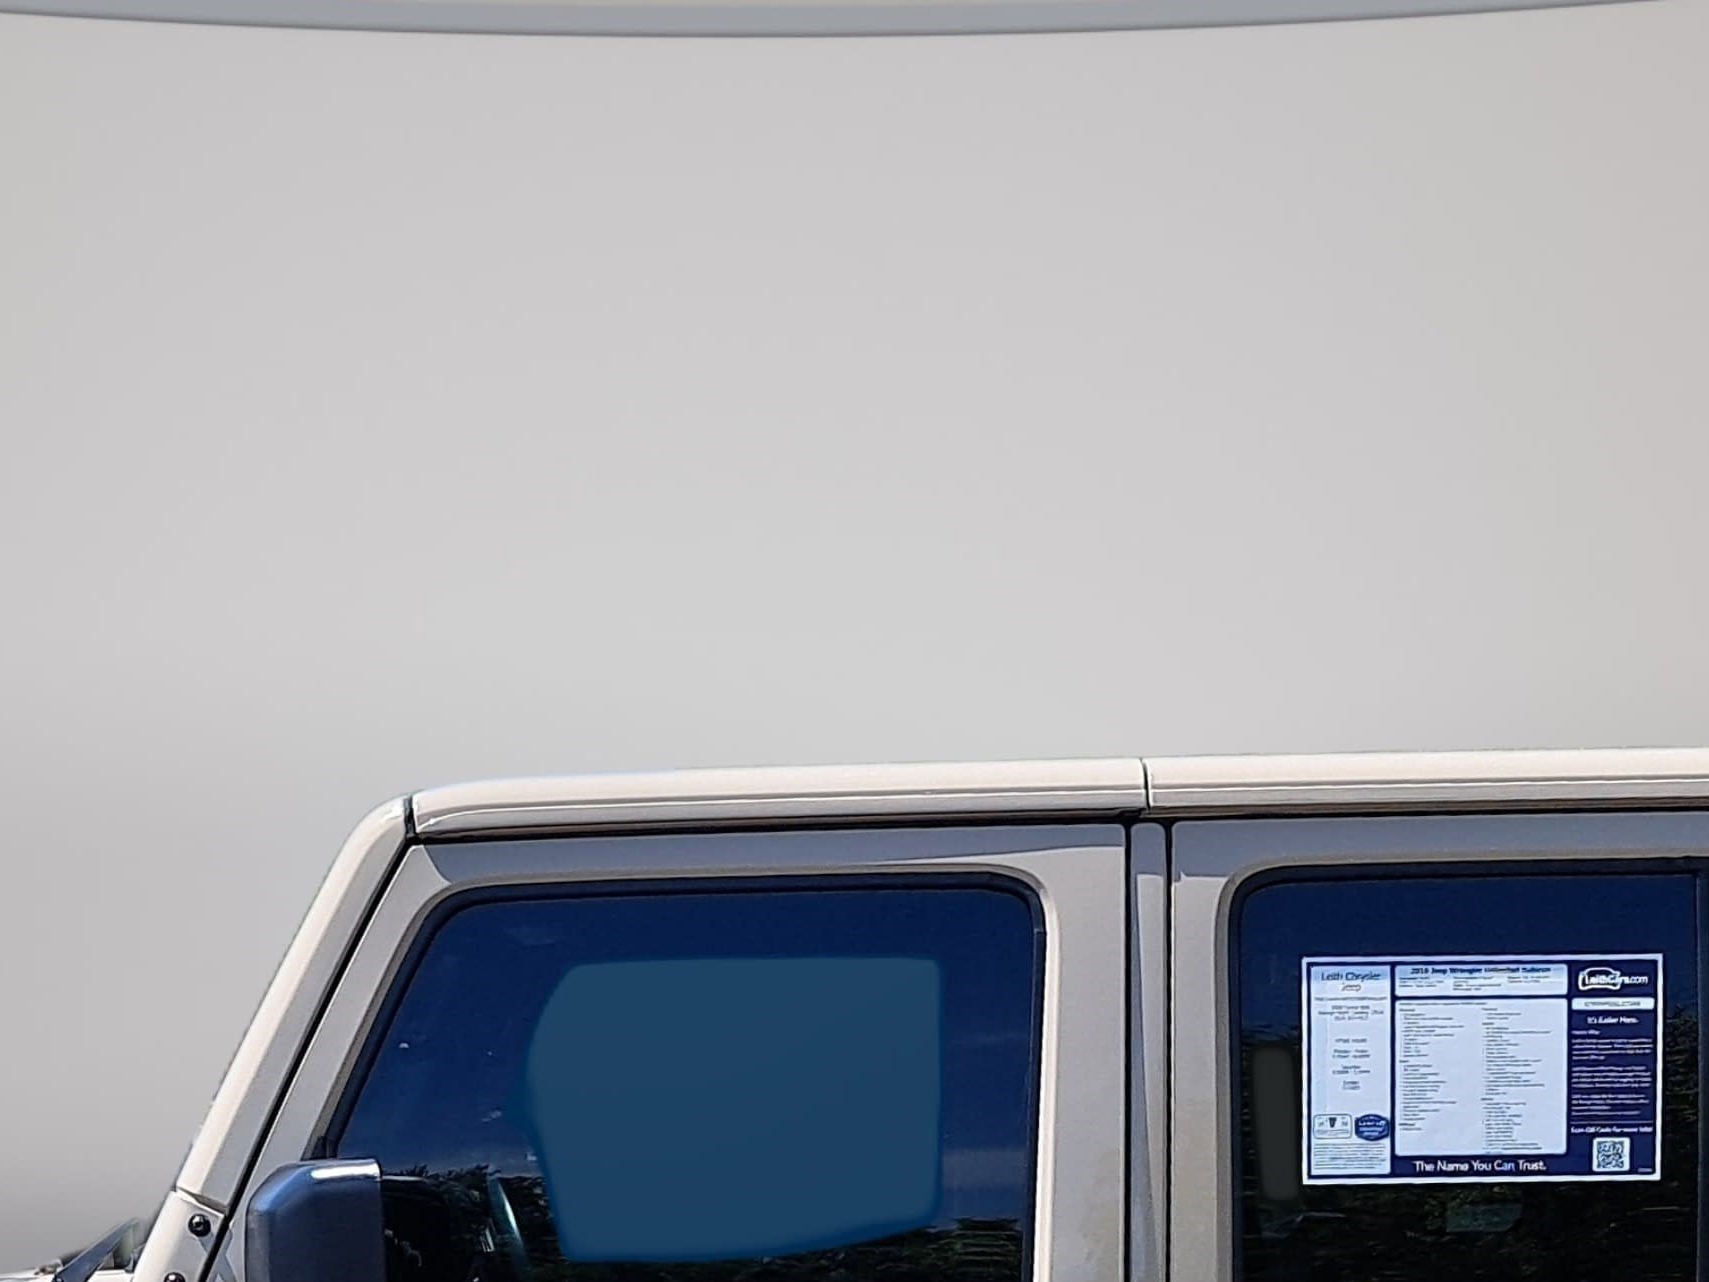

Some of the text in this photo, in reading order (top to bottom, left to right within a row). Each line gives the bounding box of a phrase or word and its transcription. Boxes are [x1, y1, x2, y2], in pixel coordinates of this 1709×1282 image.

[1321, 971, 1343, 981] Leith
[1413, 1160, 1546, 1172] The Name You Can Trust.
